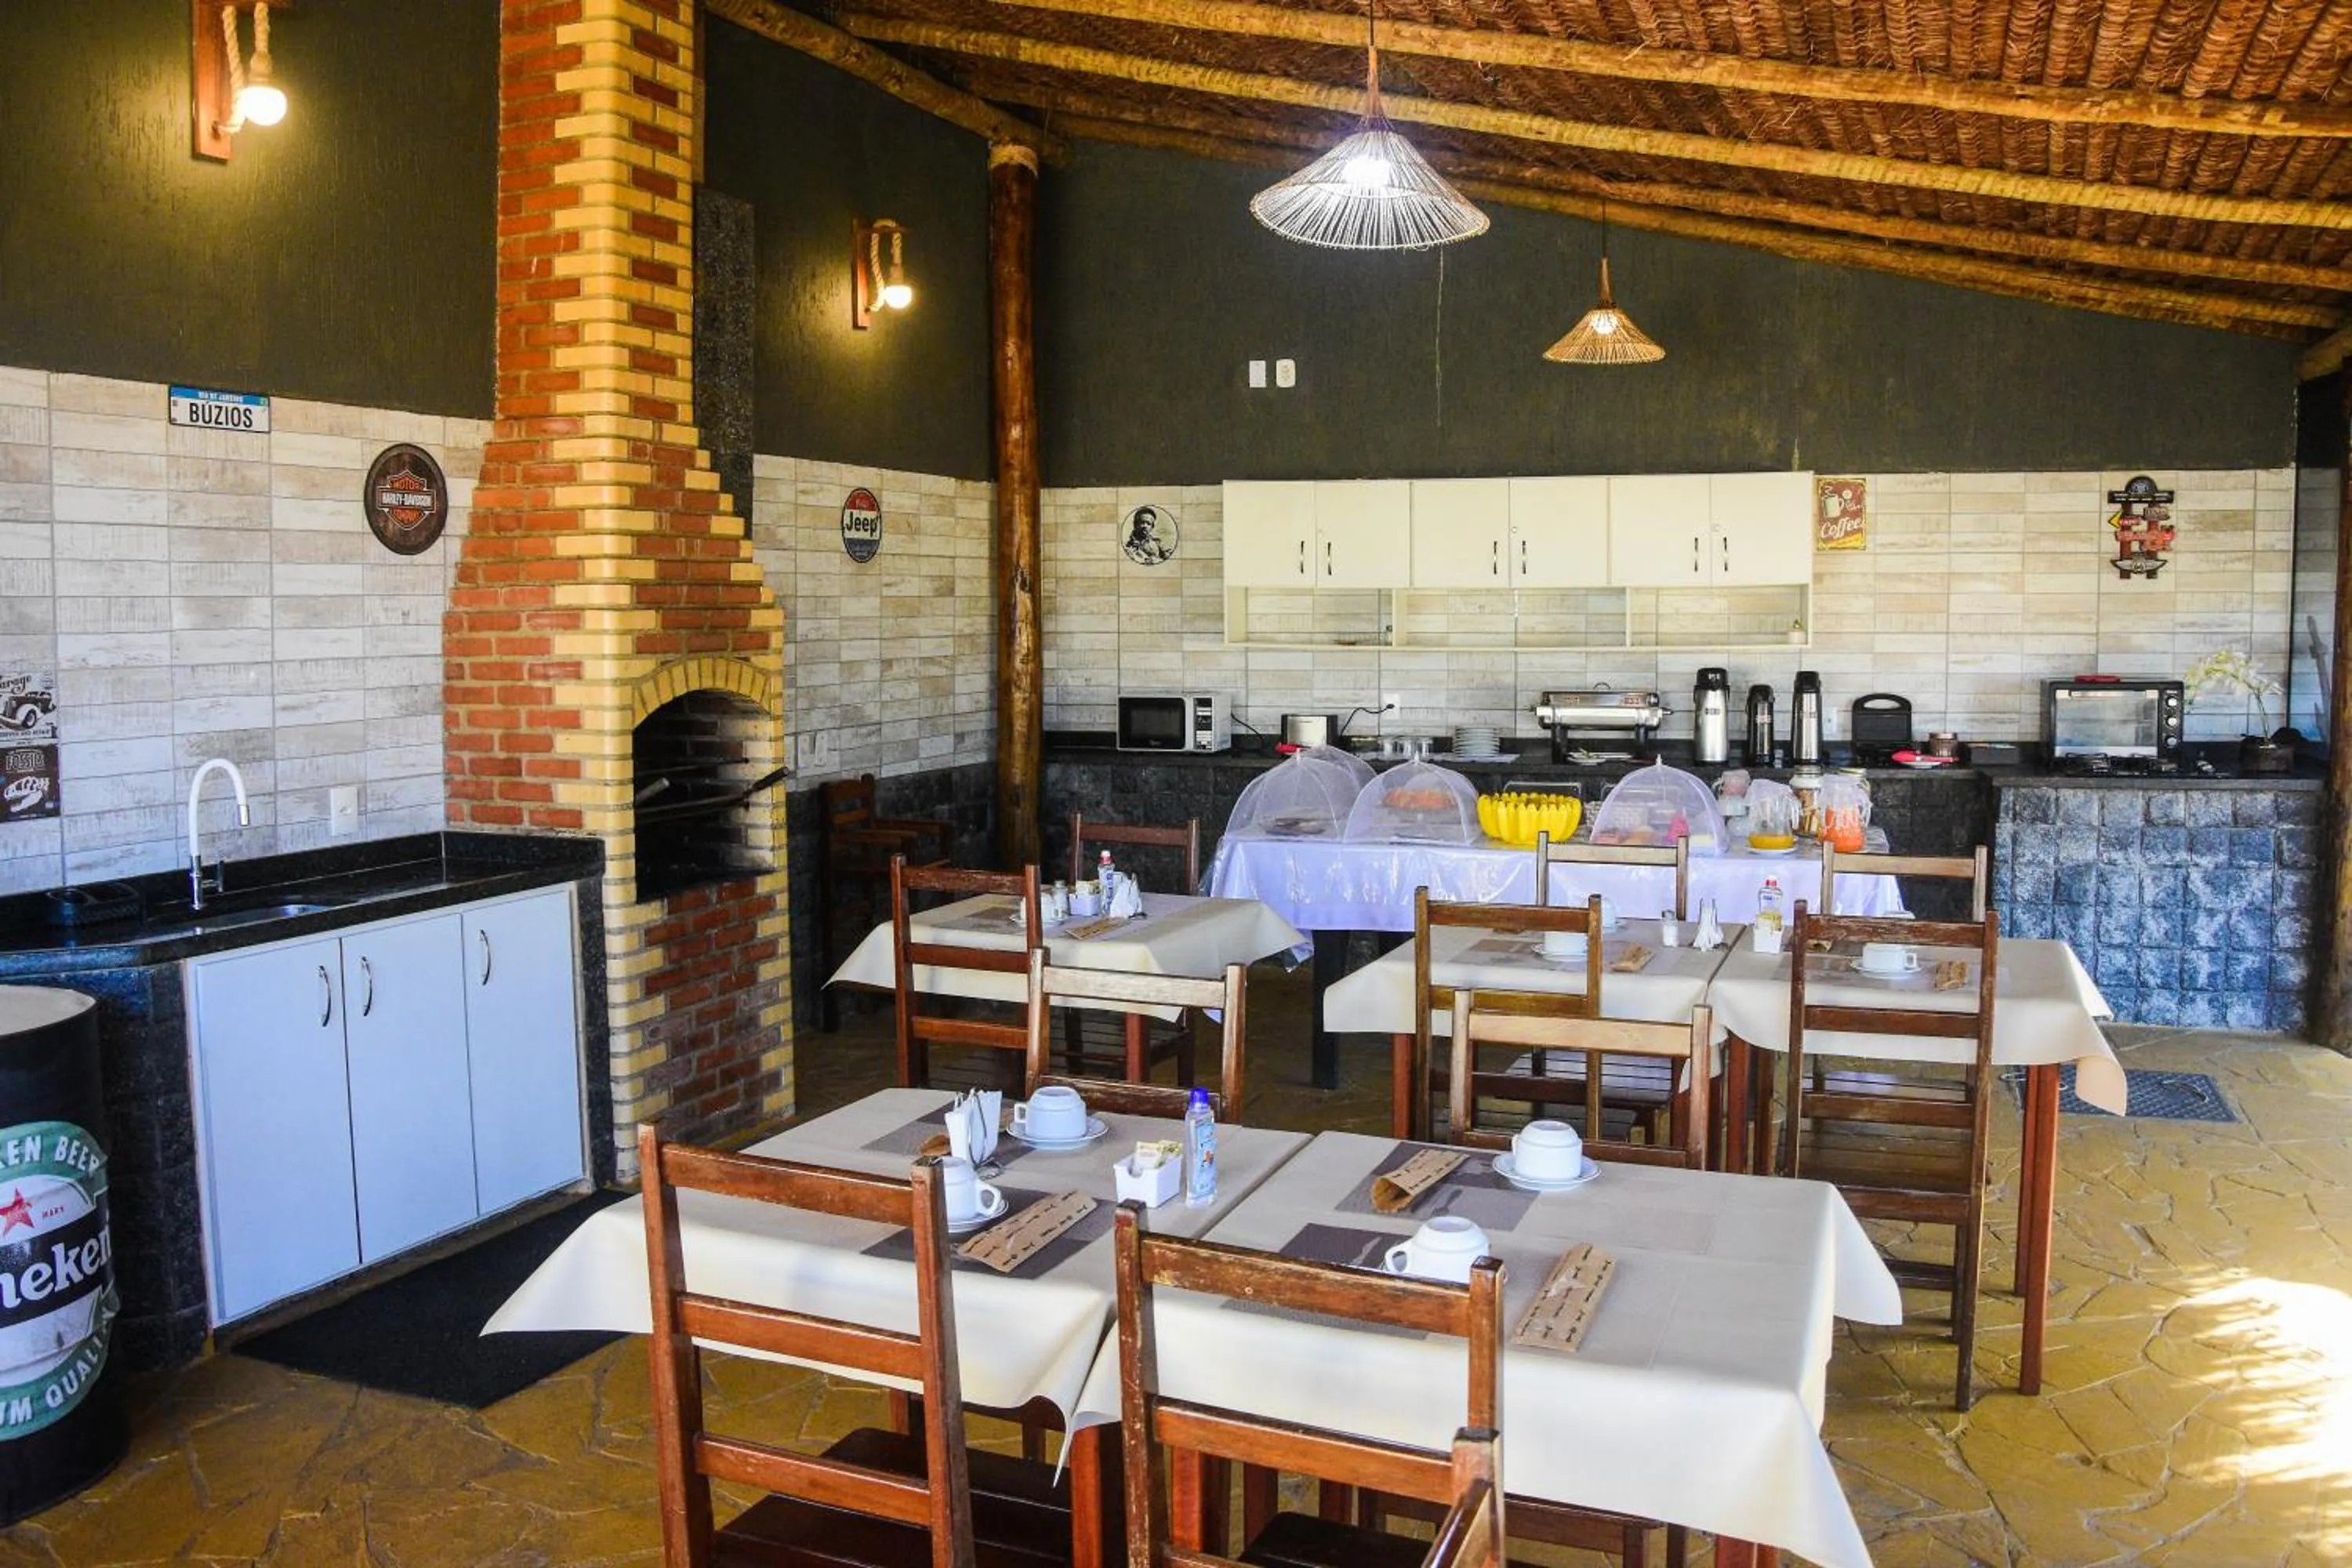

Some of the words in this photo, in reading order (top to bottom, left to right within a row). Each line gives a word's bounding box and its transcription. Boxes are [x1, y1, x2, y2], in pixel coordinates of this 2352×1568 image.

[189, 401, 253, 428] BÚZIOS
[846, 510, 878, 538] Jeep
[1821, 517, 1861, 539] Coffee
[0, 675, 31, 695] arage
[0, 1135, 42, 1168] EN
[54, 1136, 100, 1177] BEER
